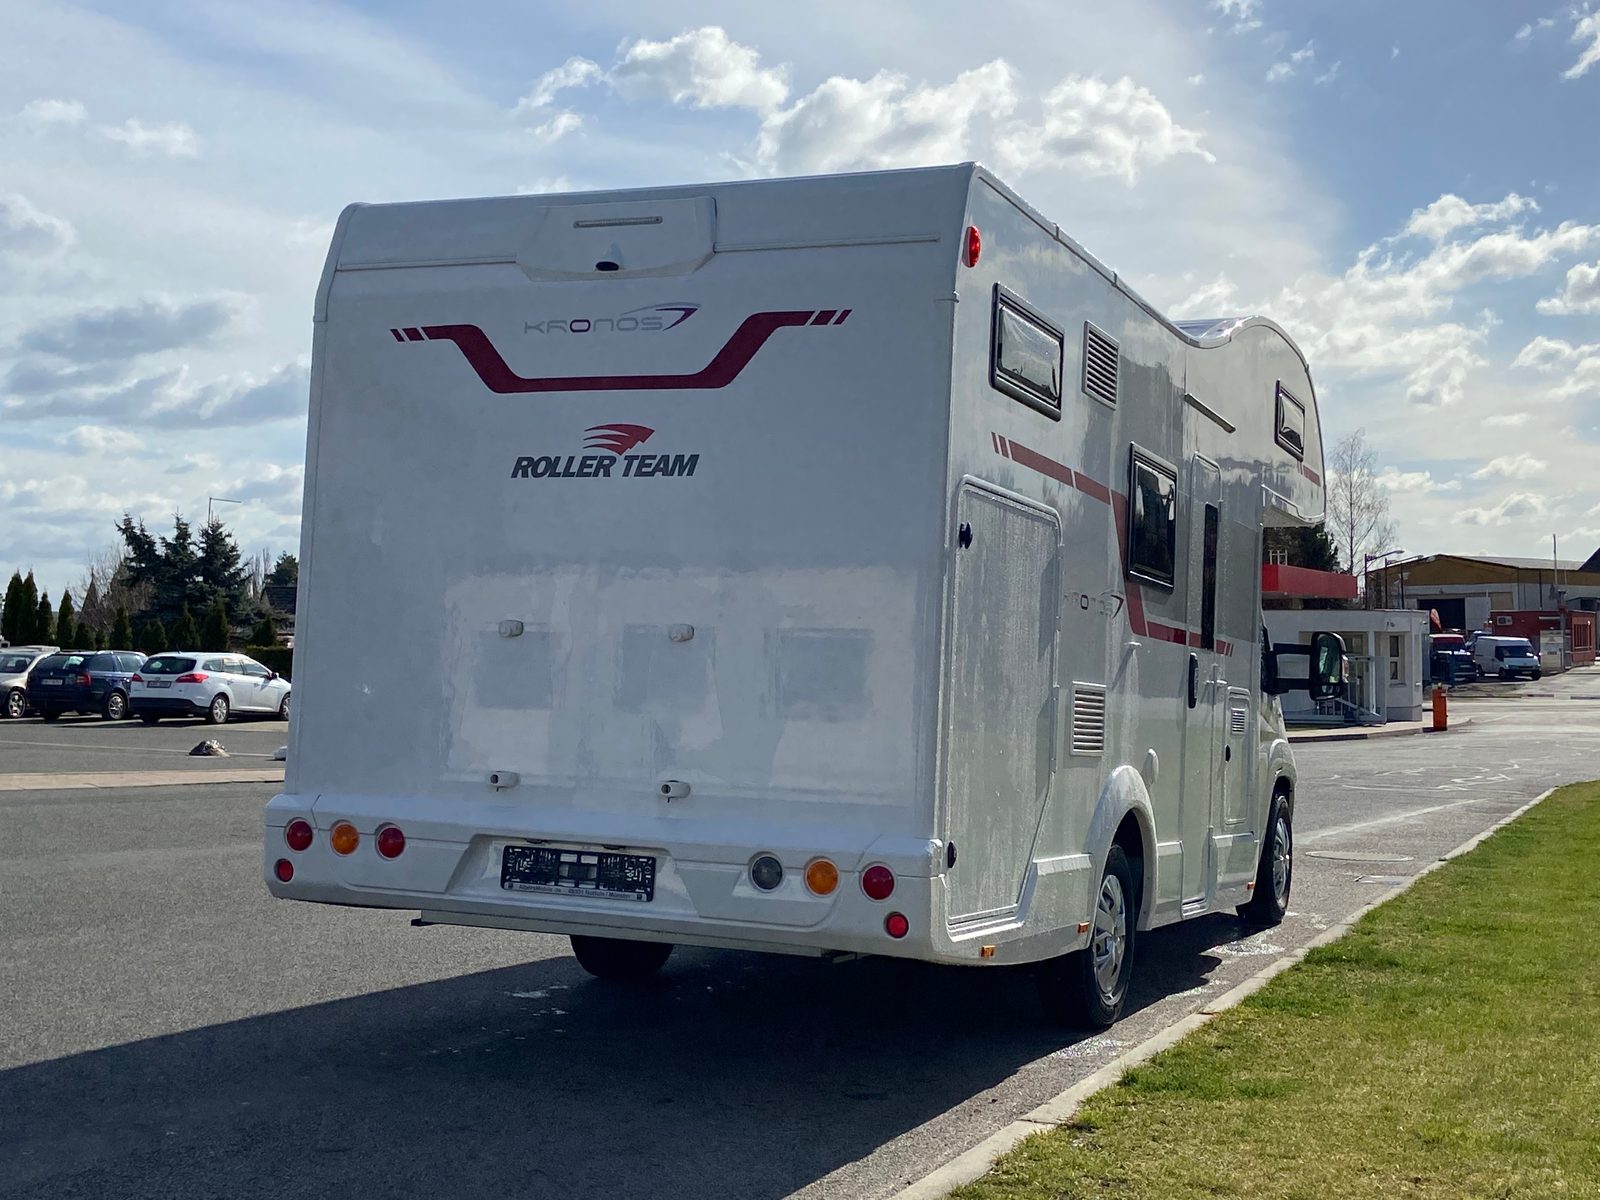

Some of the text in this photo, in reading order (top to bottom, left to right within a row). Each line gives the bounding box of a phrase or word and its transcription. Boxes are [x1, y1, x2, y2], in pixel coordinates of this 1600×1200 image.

[524, 315, 663, 335] KRONOS
[511, 454, 700, 478] ROLLER TEAM
